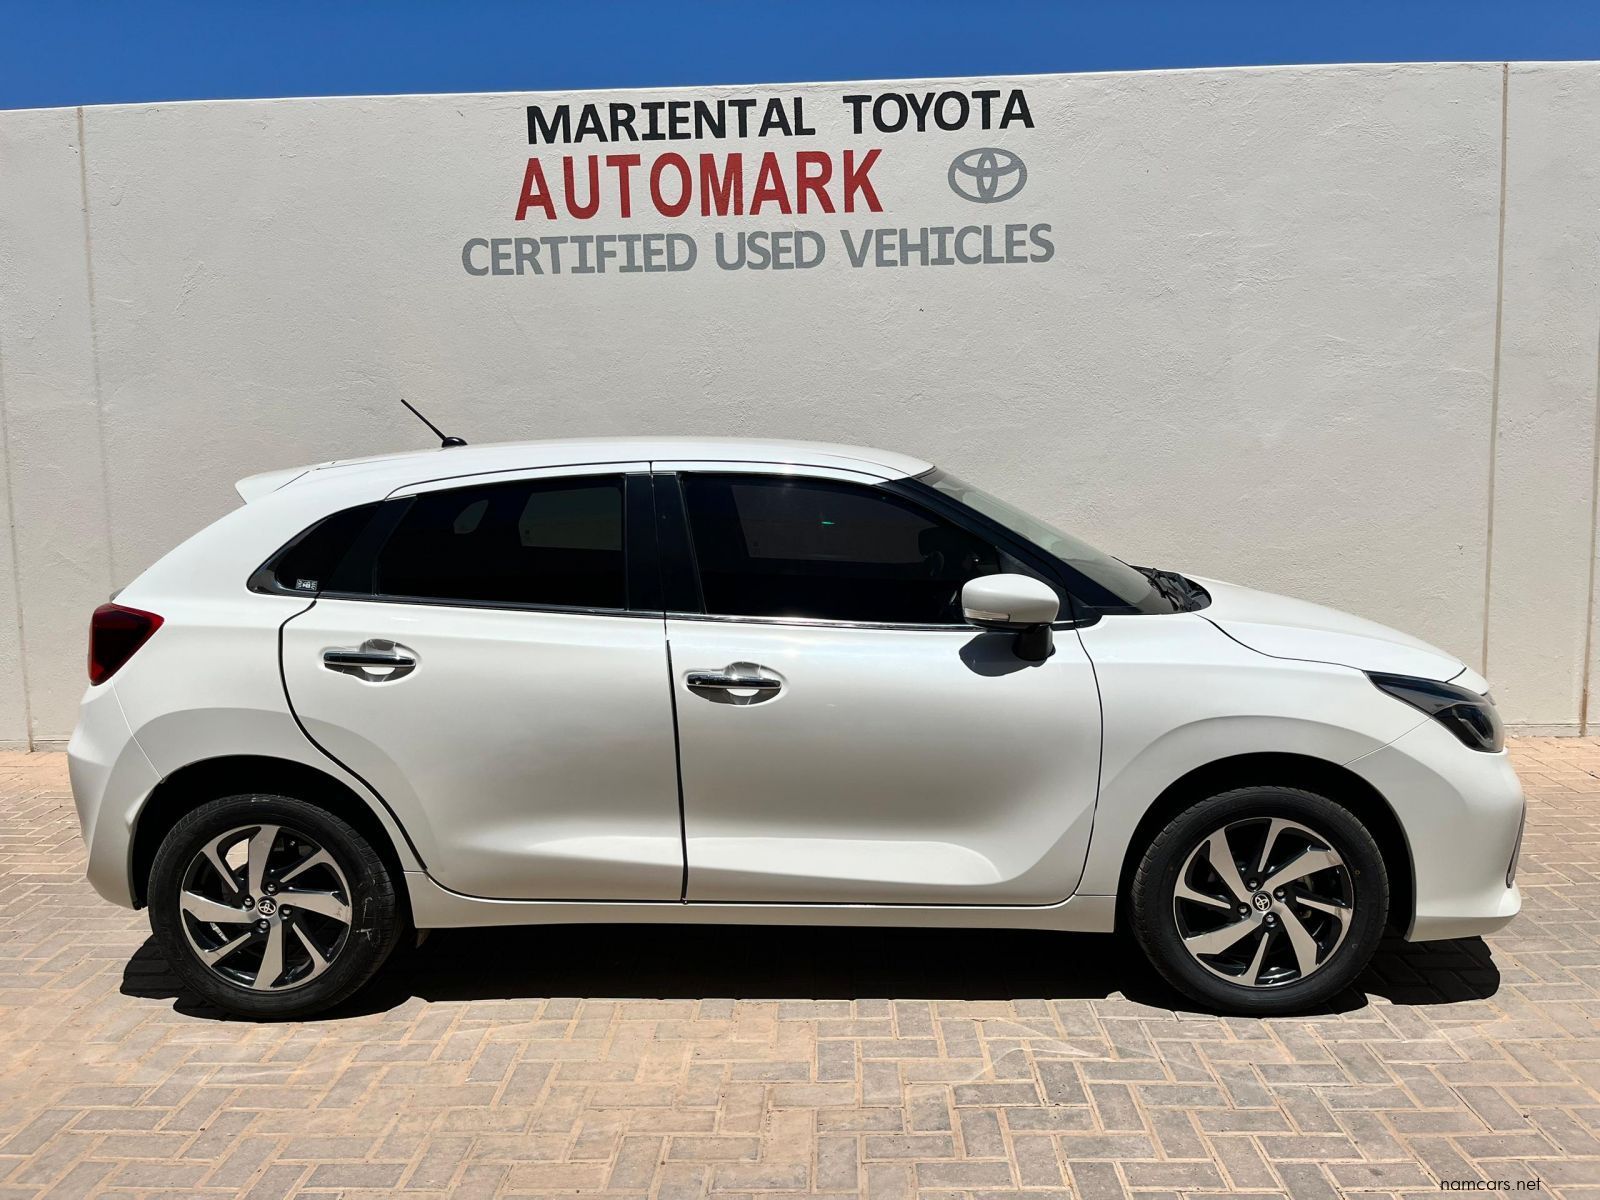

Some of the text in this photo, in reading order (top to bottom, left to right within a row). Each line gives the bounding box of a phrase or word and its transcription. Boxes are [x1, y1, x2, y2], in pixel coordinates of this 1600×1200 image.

[527, 89, 1035, 144] MARIENTAL TOYOTA
[515, 149, 883, 221] AUTOMARK
[462, 223, 1055, 276] CERTIFIED USED VEHICLES
